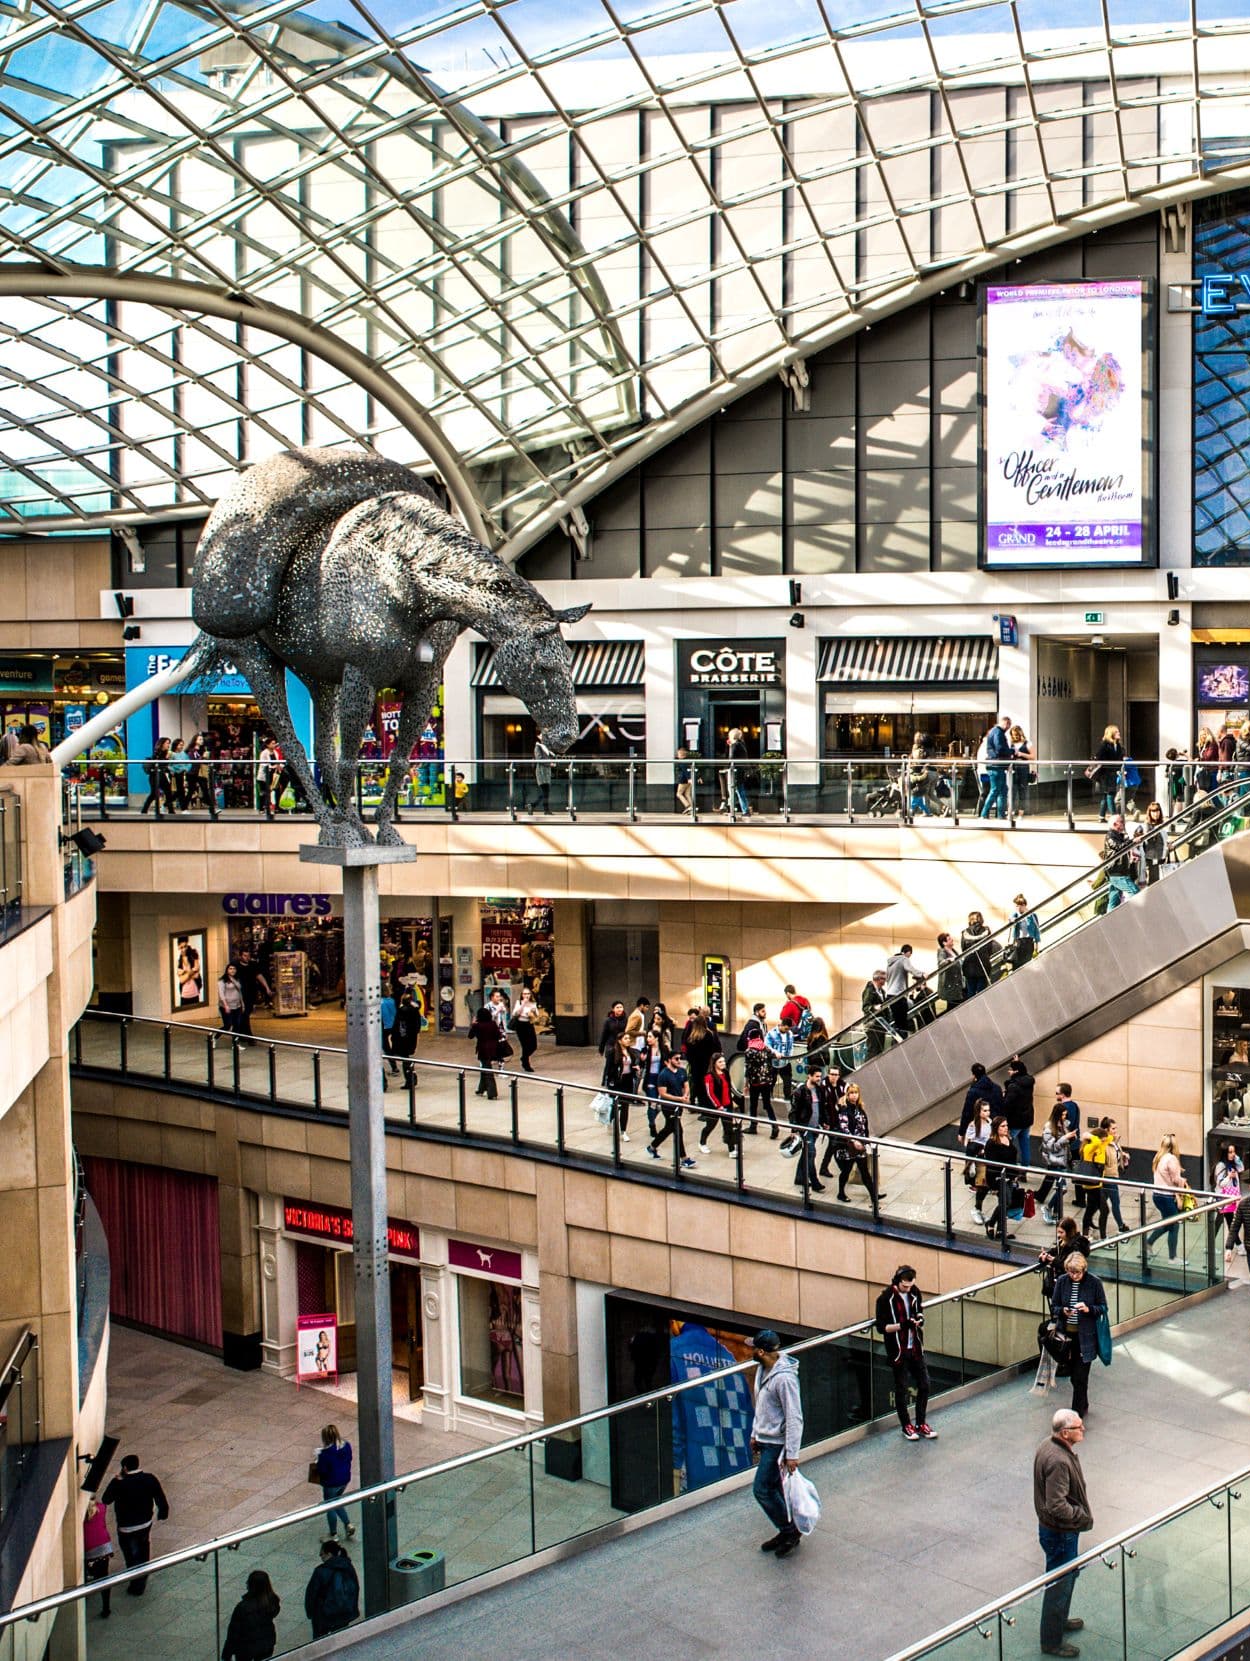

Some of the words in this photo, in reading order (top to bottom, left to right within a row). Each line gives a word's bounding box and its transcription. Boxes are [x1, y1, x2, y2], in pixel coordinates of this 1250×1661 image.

[996, 290, 1024, 298] WORLD
[1003, 449, 1060, 489] Officer
[1026, 467, 1124, 506] Gentleman
[998, 533, 1036, 545] GRAND
[1045, 526, 1062, 538] 24
[1074, 526, 1091, 537] 28
[1093, 524, 1131, 537] APRIL
[690, 647, 776, 673] CÔTE
[690, 673, 776, 683] BRASSERIE
[482, 943, 521, 959] FREE
[1226, 1072, 1243, 1082] ROX
[285, 1207, 341, 1237] VICTORIA'S
[386, 1227, 412, 1250] PINK
